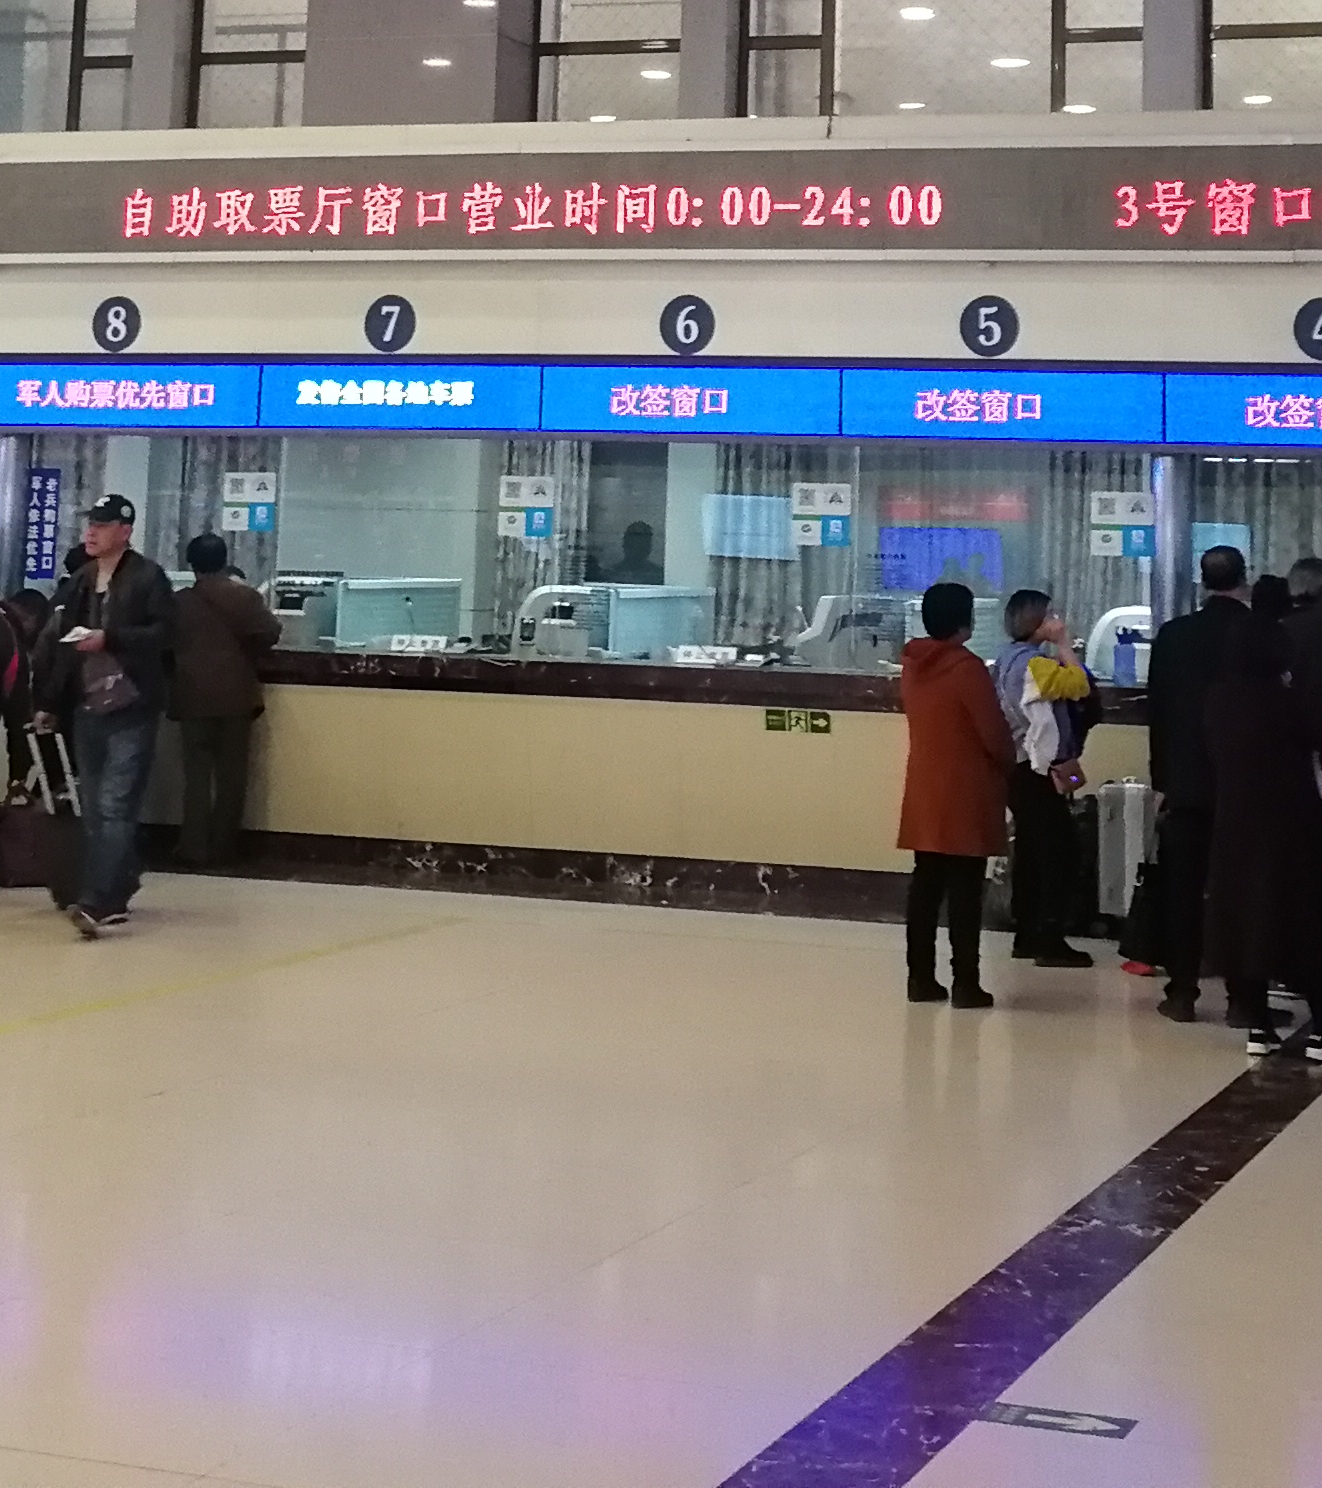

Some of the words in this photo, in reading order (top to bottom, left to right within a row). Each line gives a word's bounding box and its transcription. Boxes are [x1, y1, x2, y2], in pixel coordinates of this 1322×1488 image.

[106, 306, 127, 343] 8
[381, 306, 400, 342] 7
[676, 306, 699, 344] 6
[977, 307, 1002, 347] 5
[16, 379, 215, 409] 军人购票优先窗口
[609, 383, 729, 418] 改签窗口
[914, 389, 1042, 423] 改签窗口
